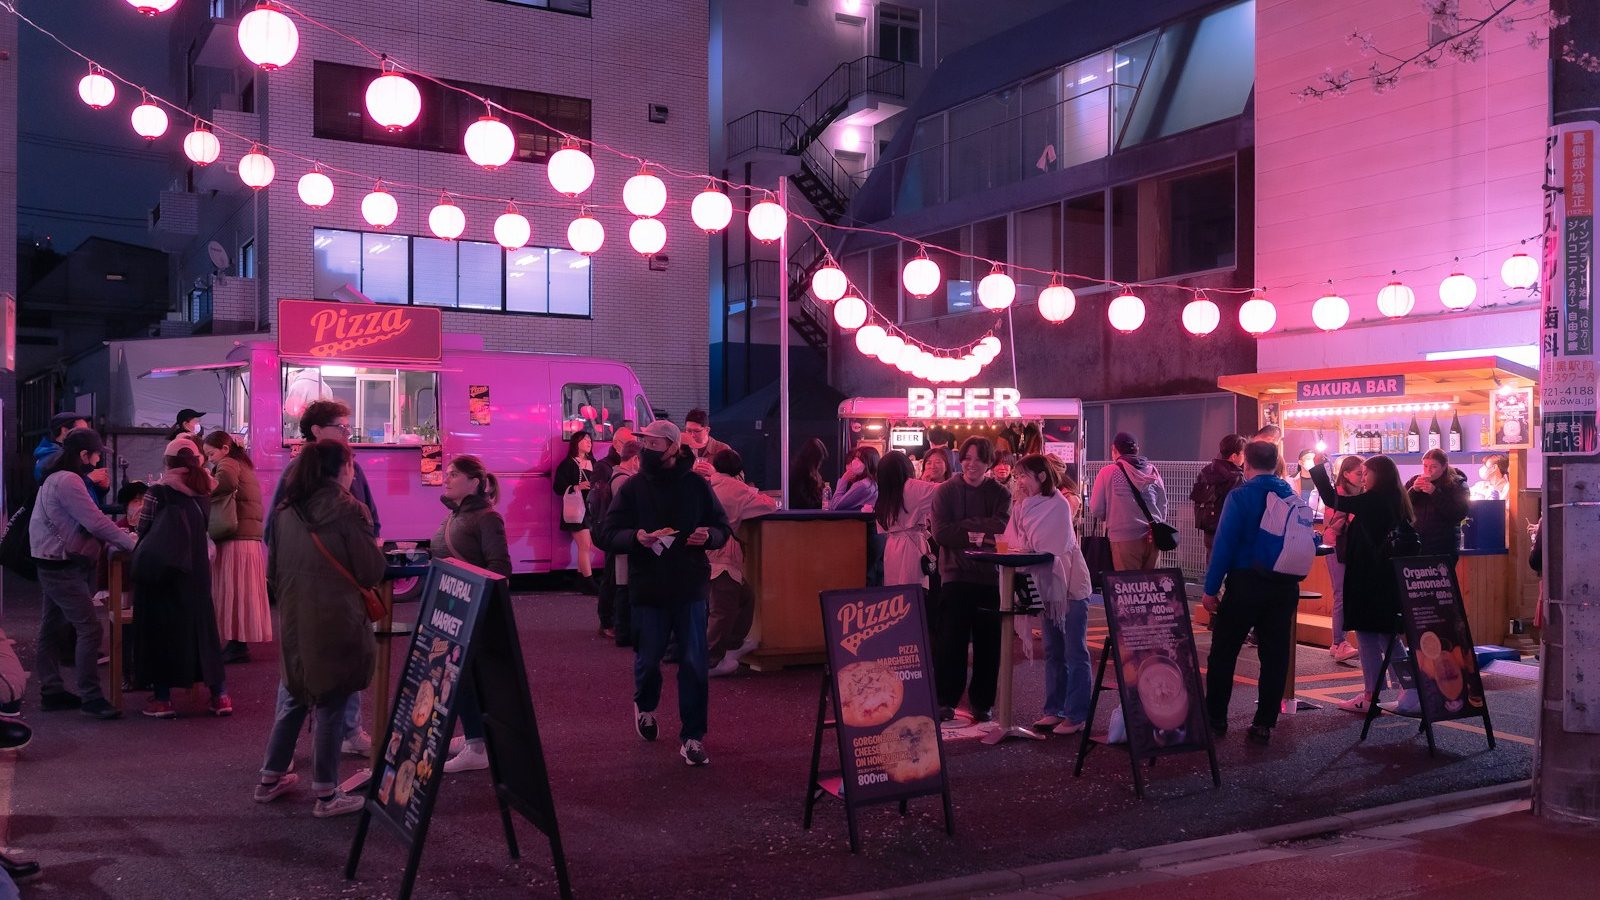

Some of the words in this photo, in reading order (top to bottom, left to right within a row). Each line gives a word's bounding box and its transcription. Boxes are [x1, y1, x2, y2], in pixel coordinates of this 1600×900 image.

[309, 308, 410, 343] Pizza
[1302, 381, 1361, 398] SAKURA
[1366, 379, 1397, 393] BAR
[908, 387, 1022, 418] BEER
[896, 434, 919, 442] BEER
[1545, 435, 1582, 447] 1-13
[1403, 566, 1438, 579] Organic
[438, 573, 472, 602] NATURAL
[1115, 582, 1157, 594] SAKURA
[1118, 593, 1167, 604] AMAZAKE
[837, 594, 911, 635] Pizza
[430, 608, 464, 637] MARKET
[898, 644, 919, 655] PIZZA
[855, 757, 867, 768] ON
[857, 773, 889, 786] 800YEN
